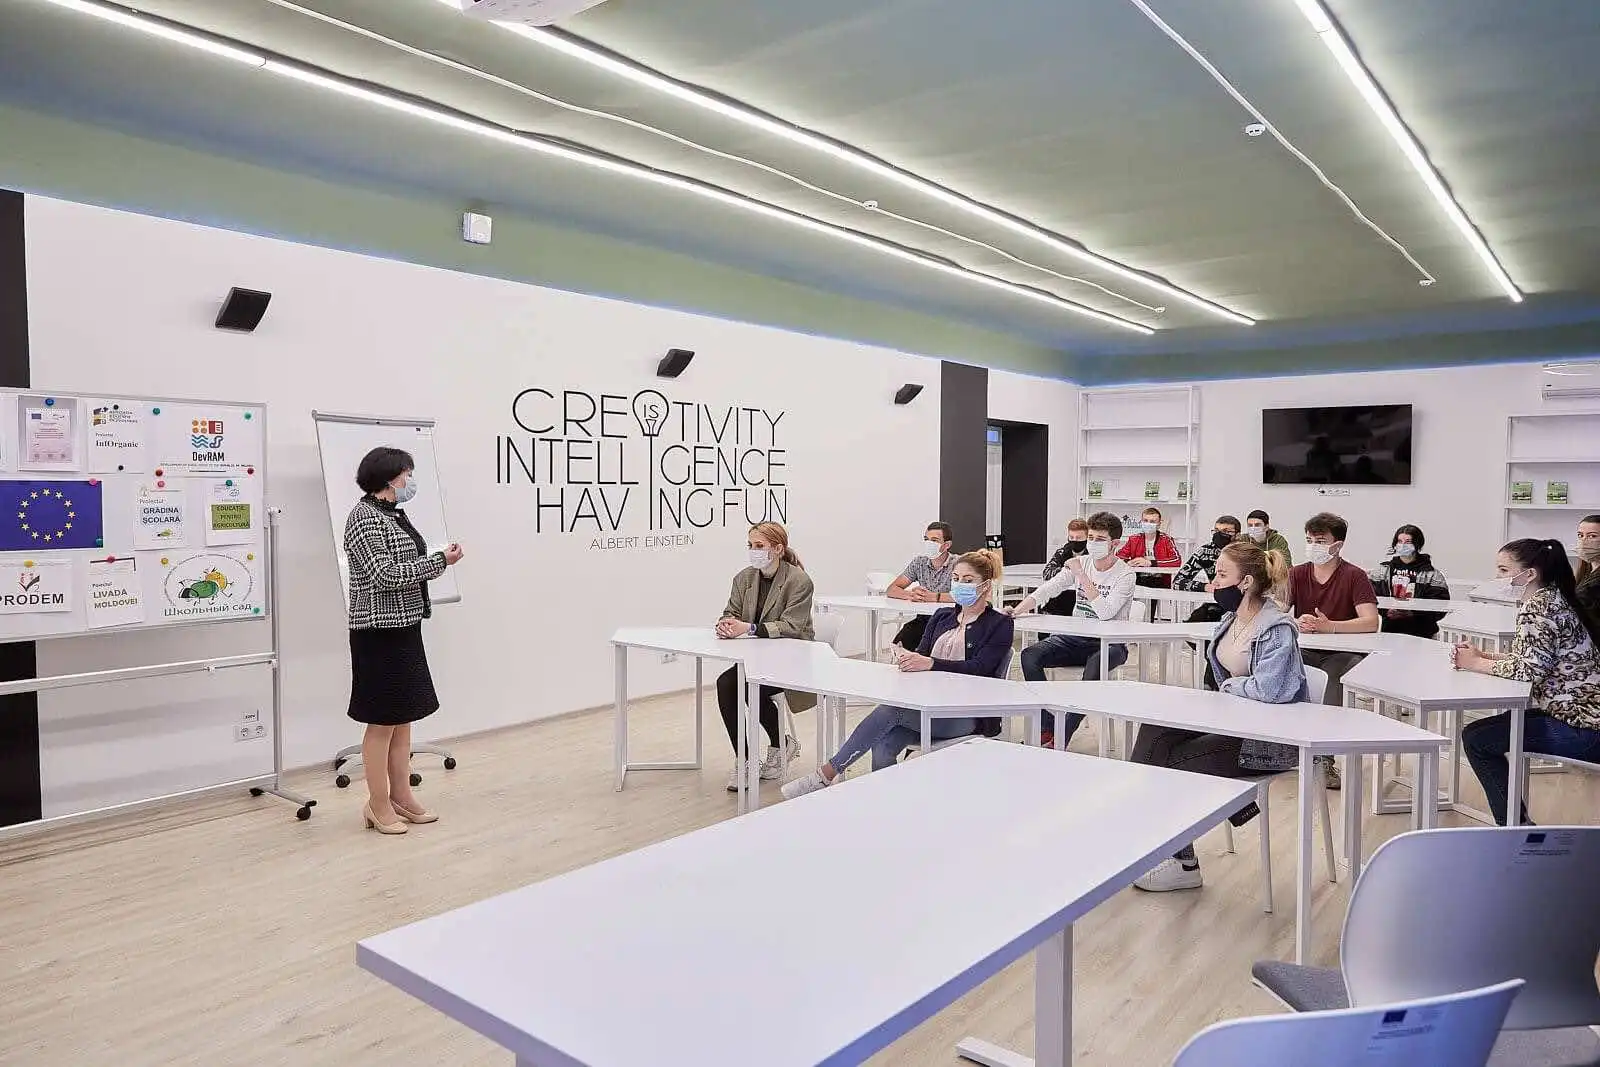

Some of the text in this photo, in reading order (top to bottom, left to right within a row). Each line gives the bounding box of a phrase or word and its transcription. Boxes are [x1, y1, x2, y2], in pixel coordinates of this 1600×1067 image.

[643, 404, 659, 418] IS
[96, 440, 139, 448] InfOrganic
[192, 451, 225, 462] DevRAM
[723, 488, 788, 527] FUN
[590, 534, 694, 550] ALBERT EINSTEIN
[0, 593, 64, 606] RODEM
[93, 588, 128, 598] LIVADA
[94, 598, 138, 608] MOLDOVEI
[164, 603, 252, 616] Школьный сад
